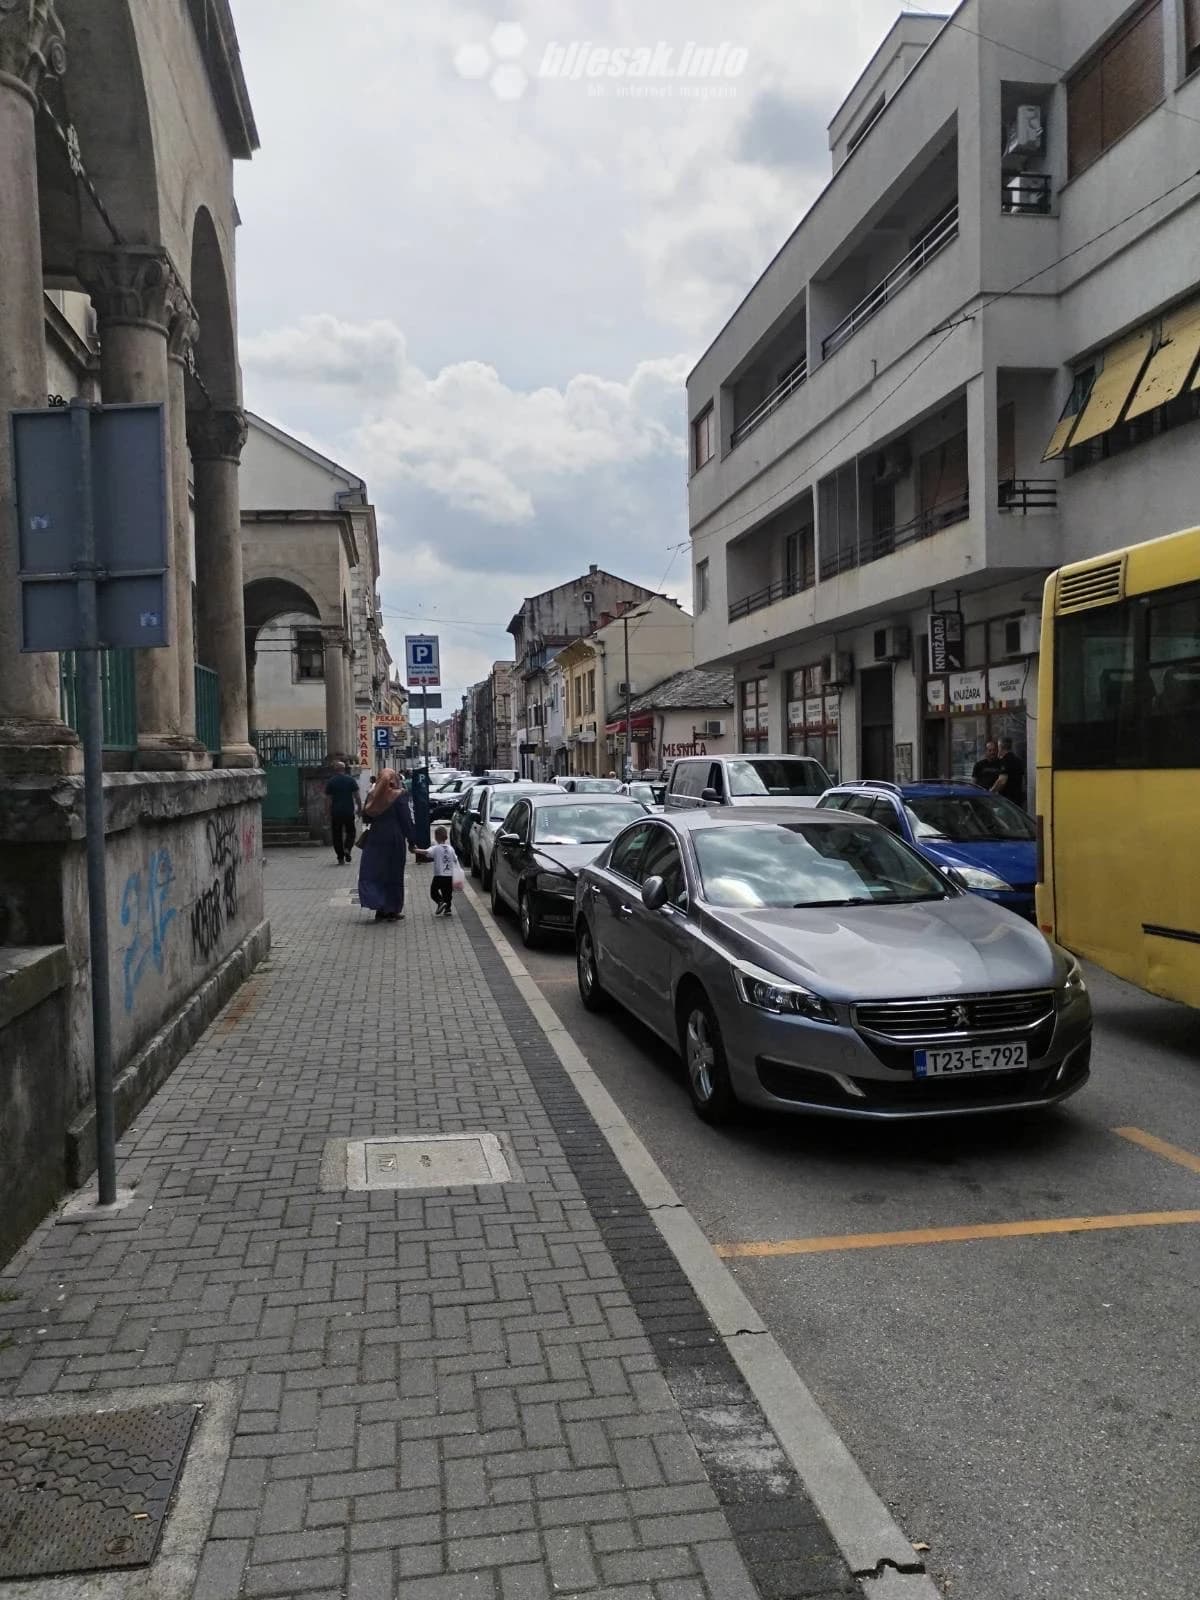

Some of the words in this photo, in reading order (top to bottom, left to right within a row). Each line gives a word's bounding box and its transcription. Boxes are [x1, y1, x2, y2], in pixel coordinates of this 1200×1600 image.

[416, 646, 429, 662] P
[360, 716, 369, 766] PEKARA
[377, 729, 387, 742] P
[663, 741, 707, 757] MESNICA
[930, 1047, 1025, 1072] T23-E-792
